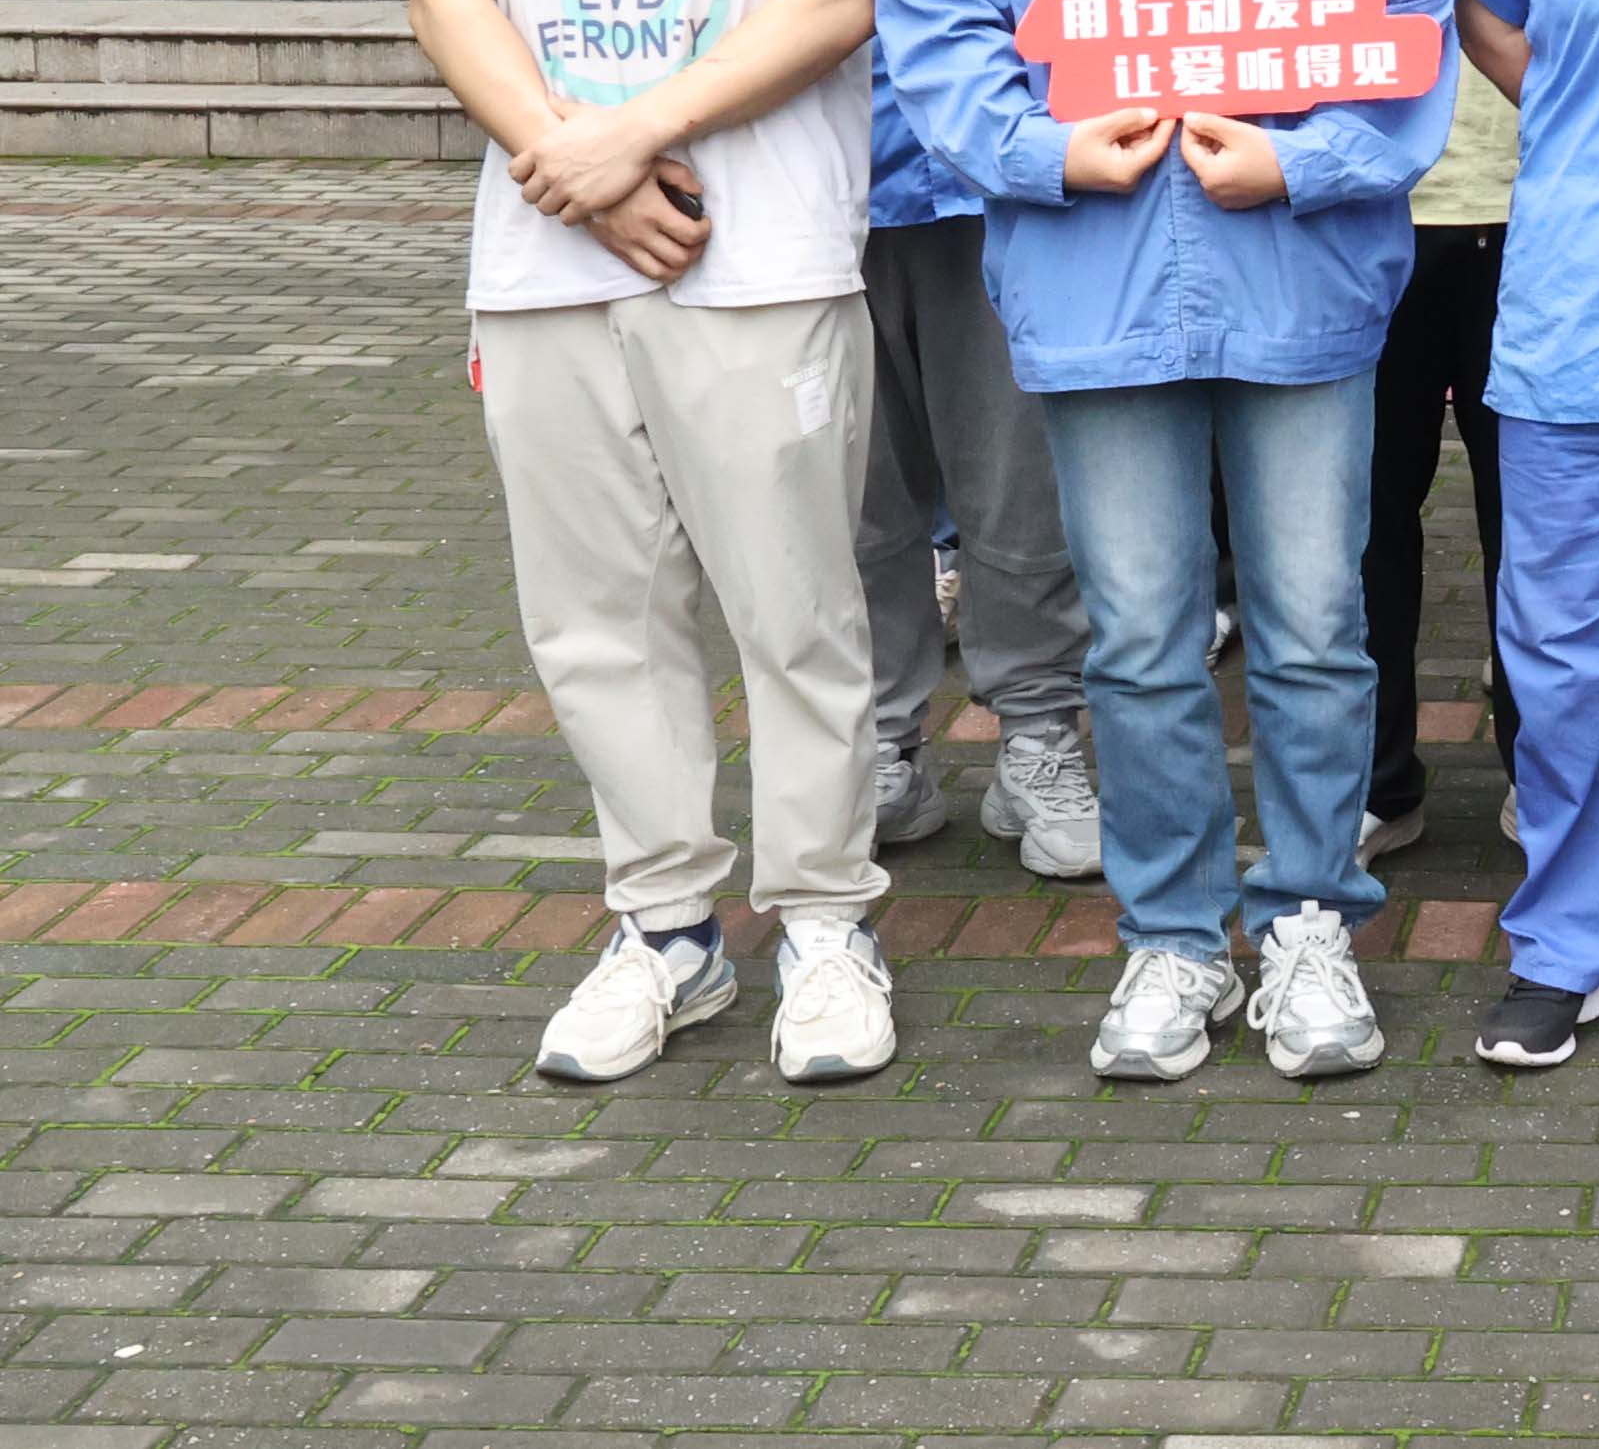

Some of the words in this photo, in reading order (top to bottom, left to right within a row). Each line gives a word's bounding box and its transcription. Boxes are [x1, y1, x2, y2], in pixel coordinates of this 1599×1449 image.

[1114, 41, 1400, 100] 让爱听得见
